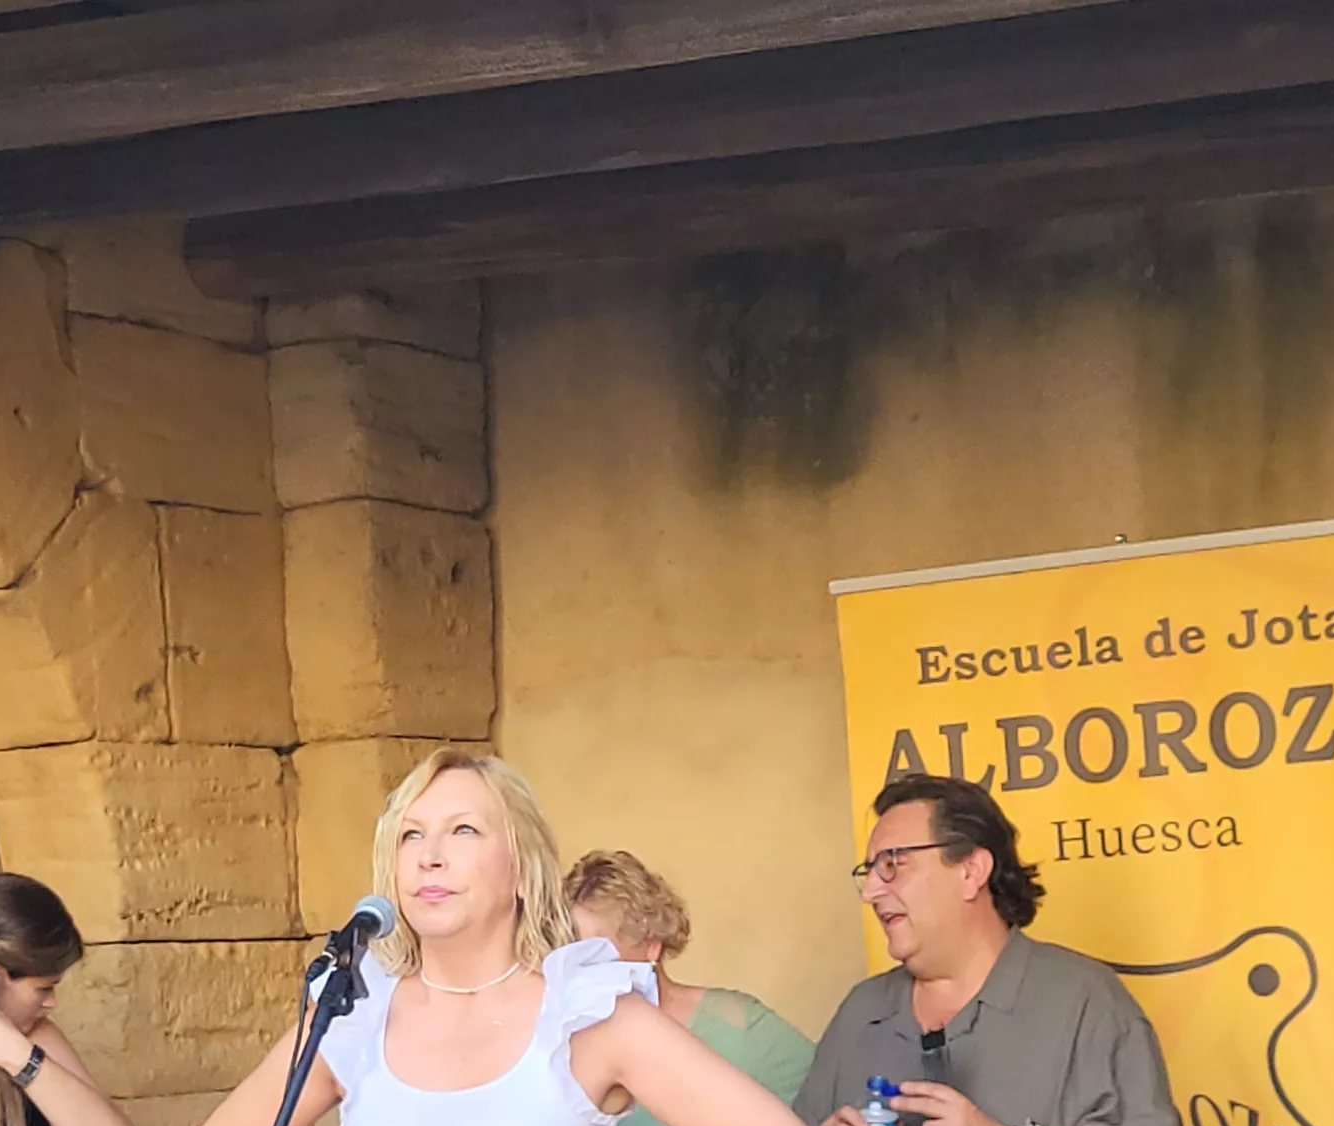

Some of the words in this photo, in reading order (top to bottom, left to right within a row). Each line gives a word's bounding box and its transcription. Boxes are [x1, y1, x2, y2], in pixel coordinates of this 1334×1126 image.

[916, 627, 1123, 685] Escuela
[1144, 617, 1206, 659] de
[1051, 815, 1242, 862] Huesca
